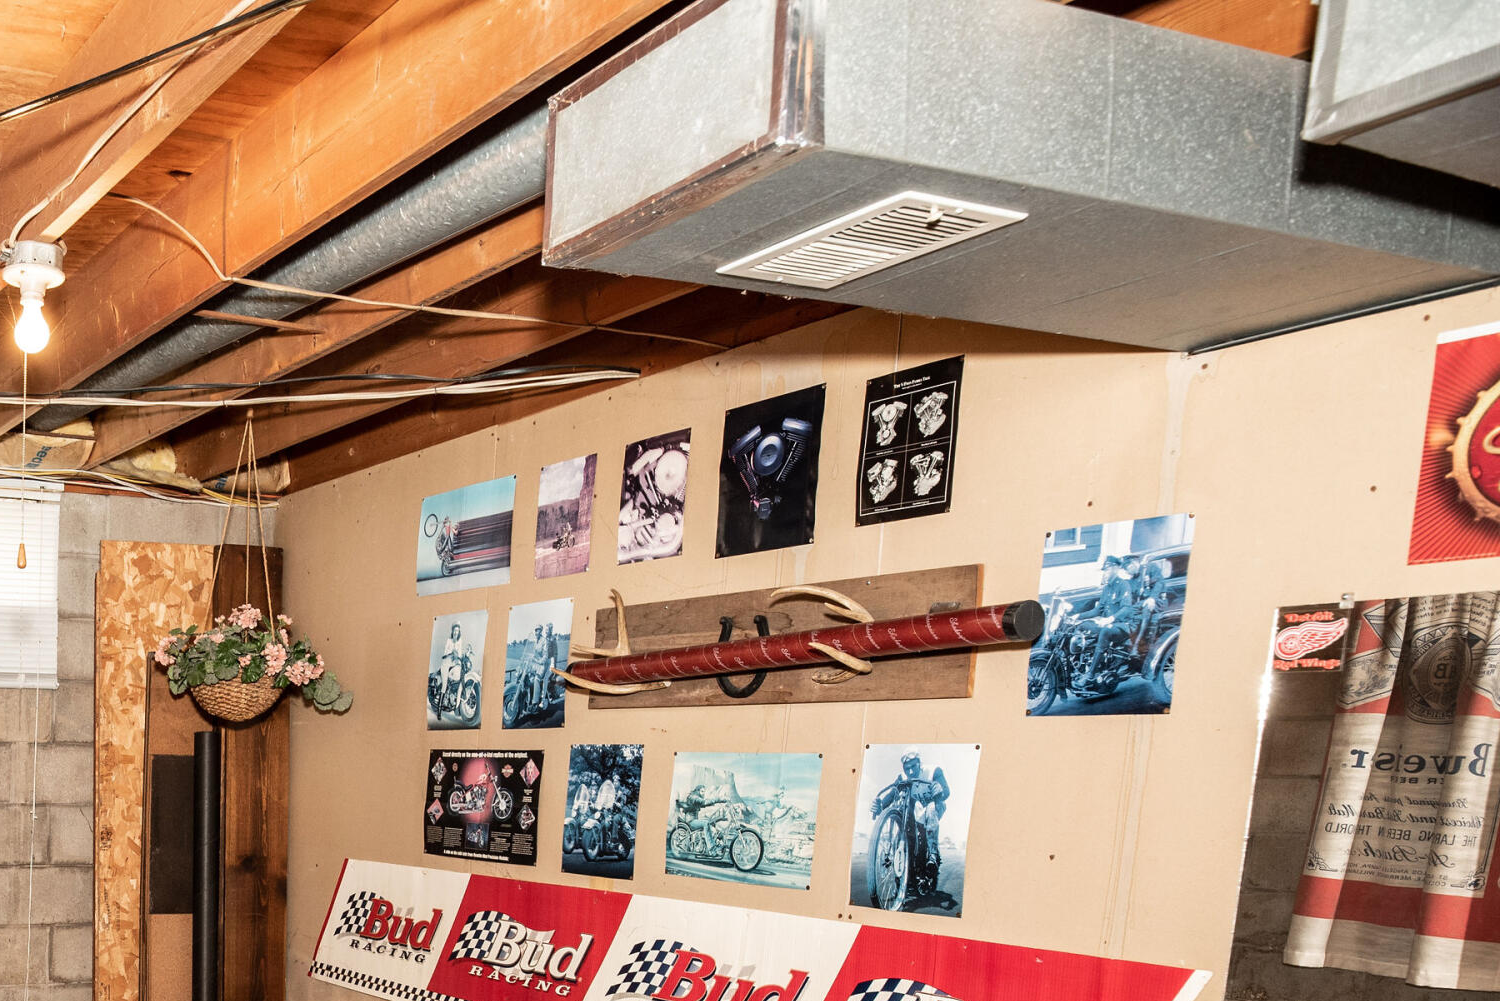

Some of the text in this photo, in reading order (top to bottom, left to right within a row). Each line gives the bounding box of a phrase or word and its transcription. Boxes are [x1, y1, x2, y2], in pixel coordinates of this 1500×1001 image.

[359, 898, 443, 952] Bud
[350, 939, 426, 963] RACING
[483, 918, 594, 983] Bud
[467, 965, 572, 997] RACING
